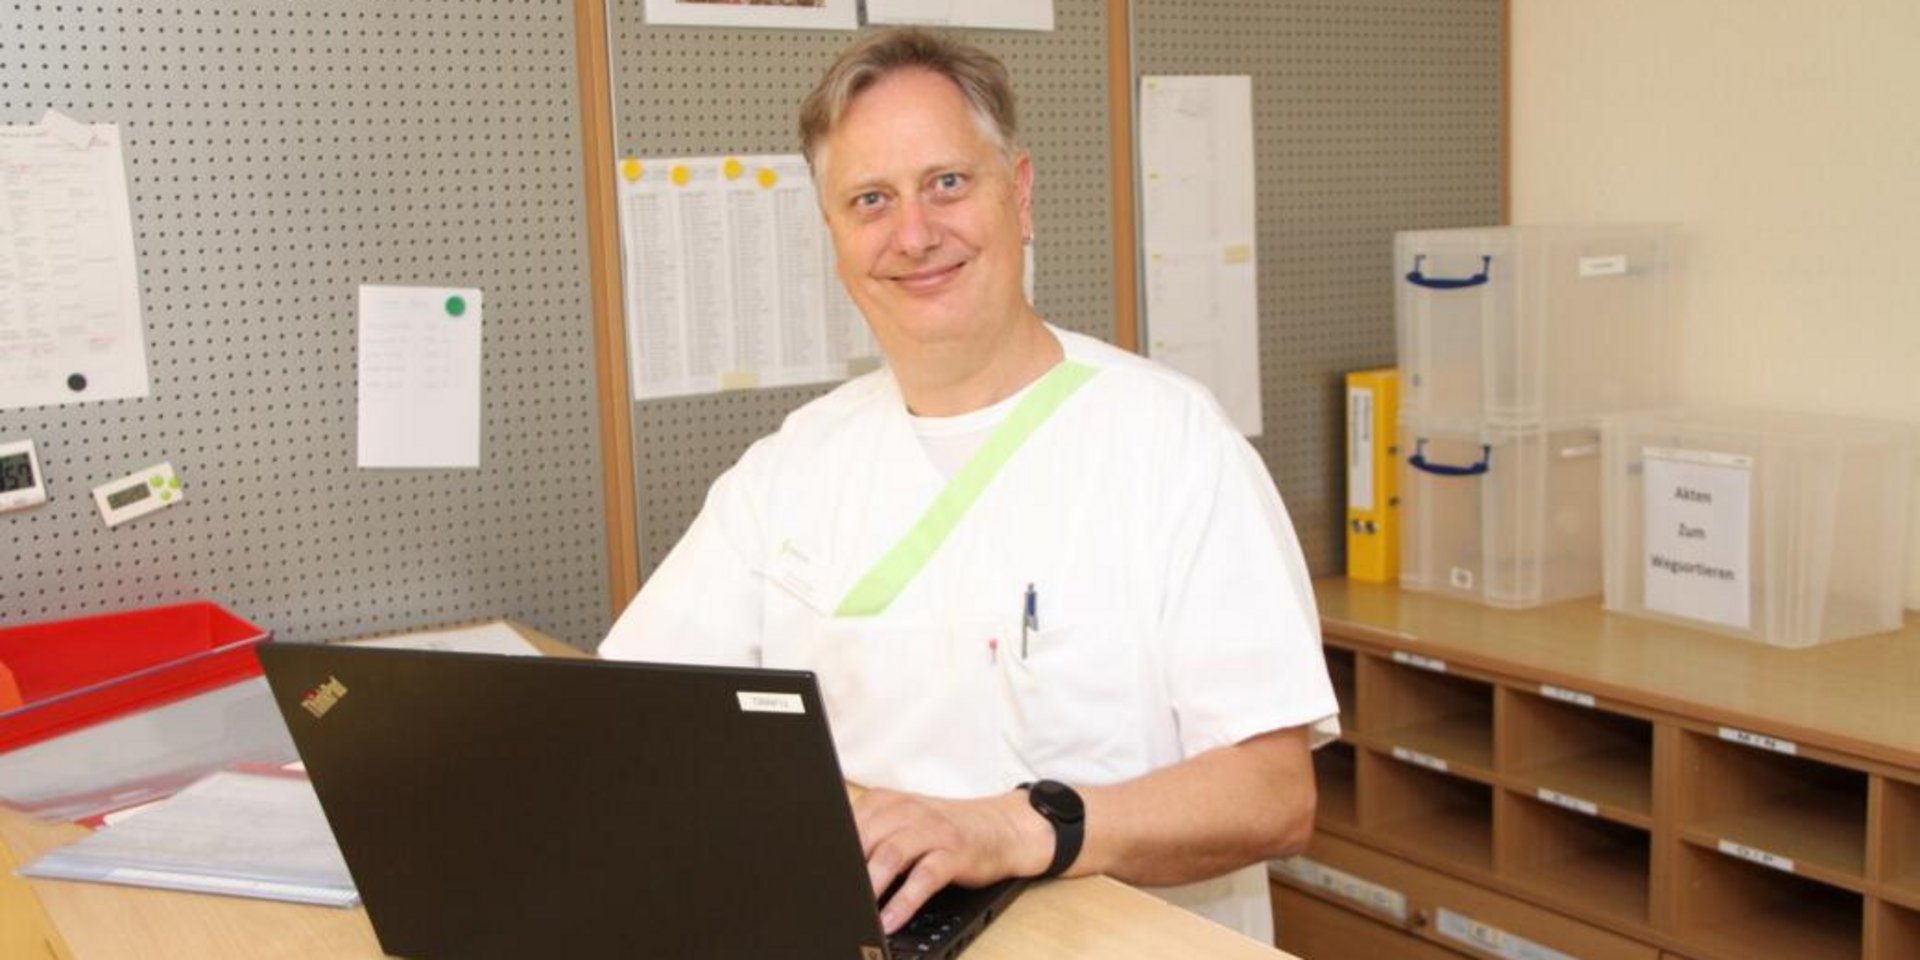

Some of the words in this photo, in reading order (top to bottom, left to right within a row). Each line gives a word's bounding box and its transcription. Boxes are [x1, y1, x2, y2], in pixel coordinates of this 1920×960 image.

[1674, 486, 1712, 505] Akten
[1678, 522, 1706, 540] Zum
[1651, 555, 1736, 581] Wegsortieren
